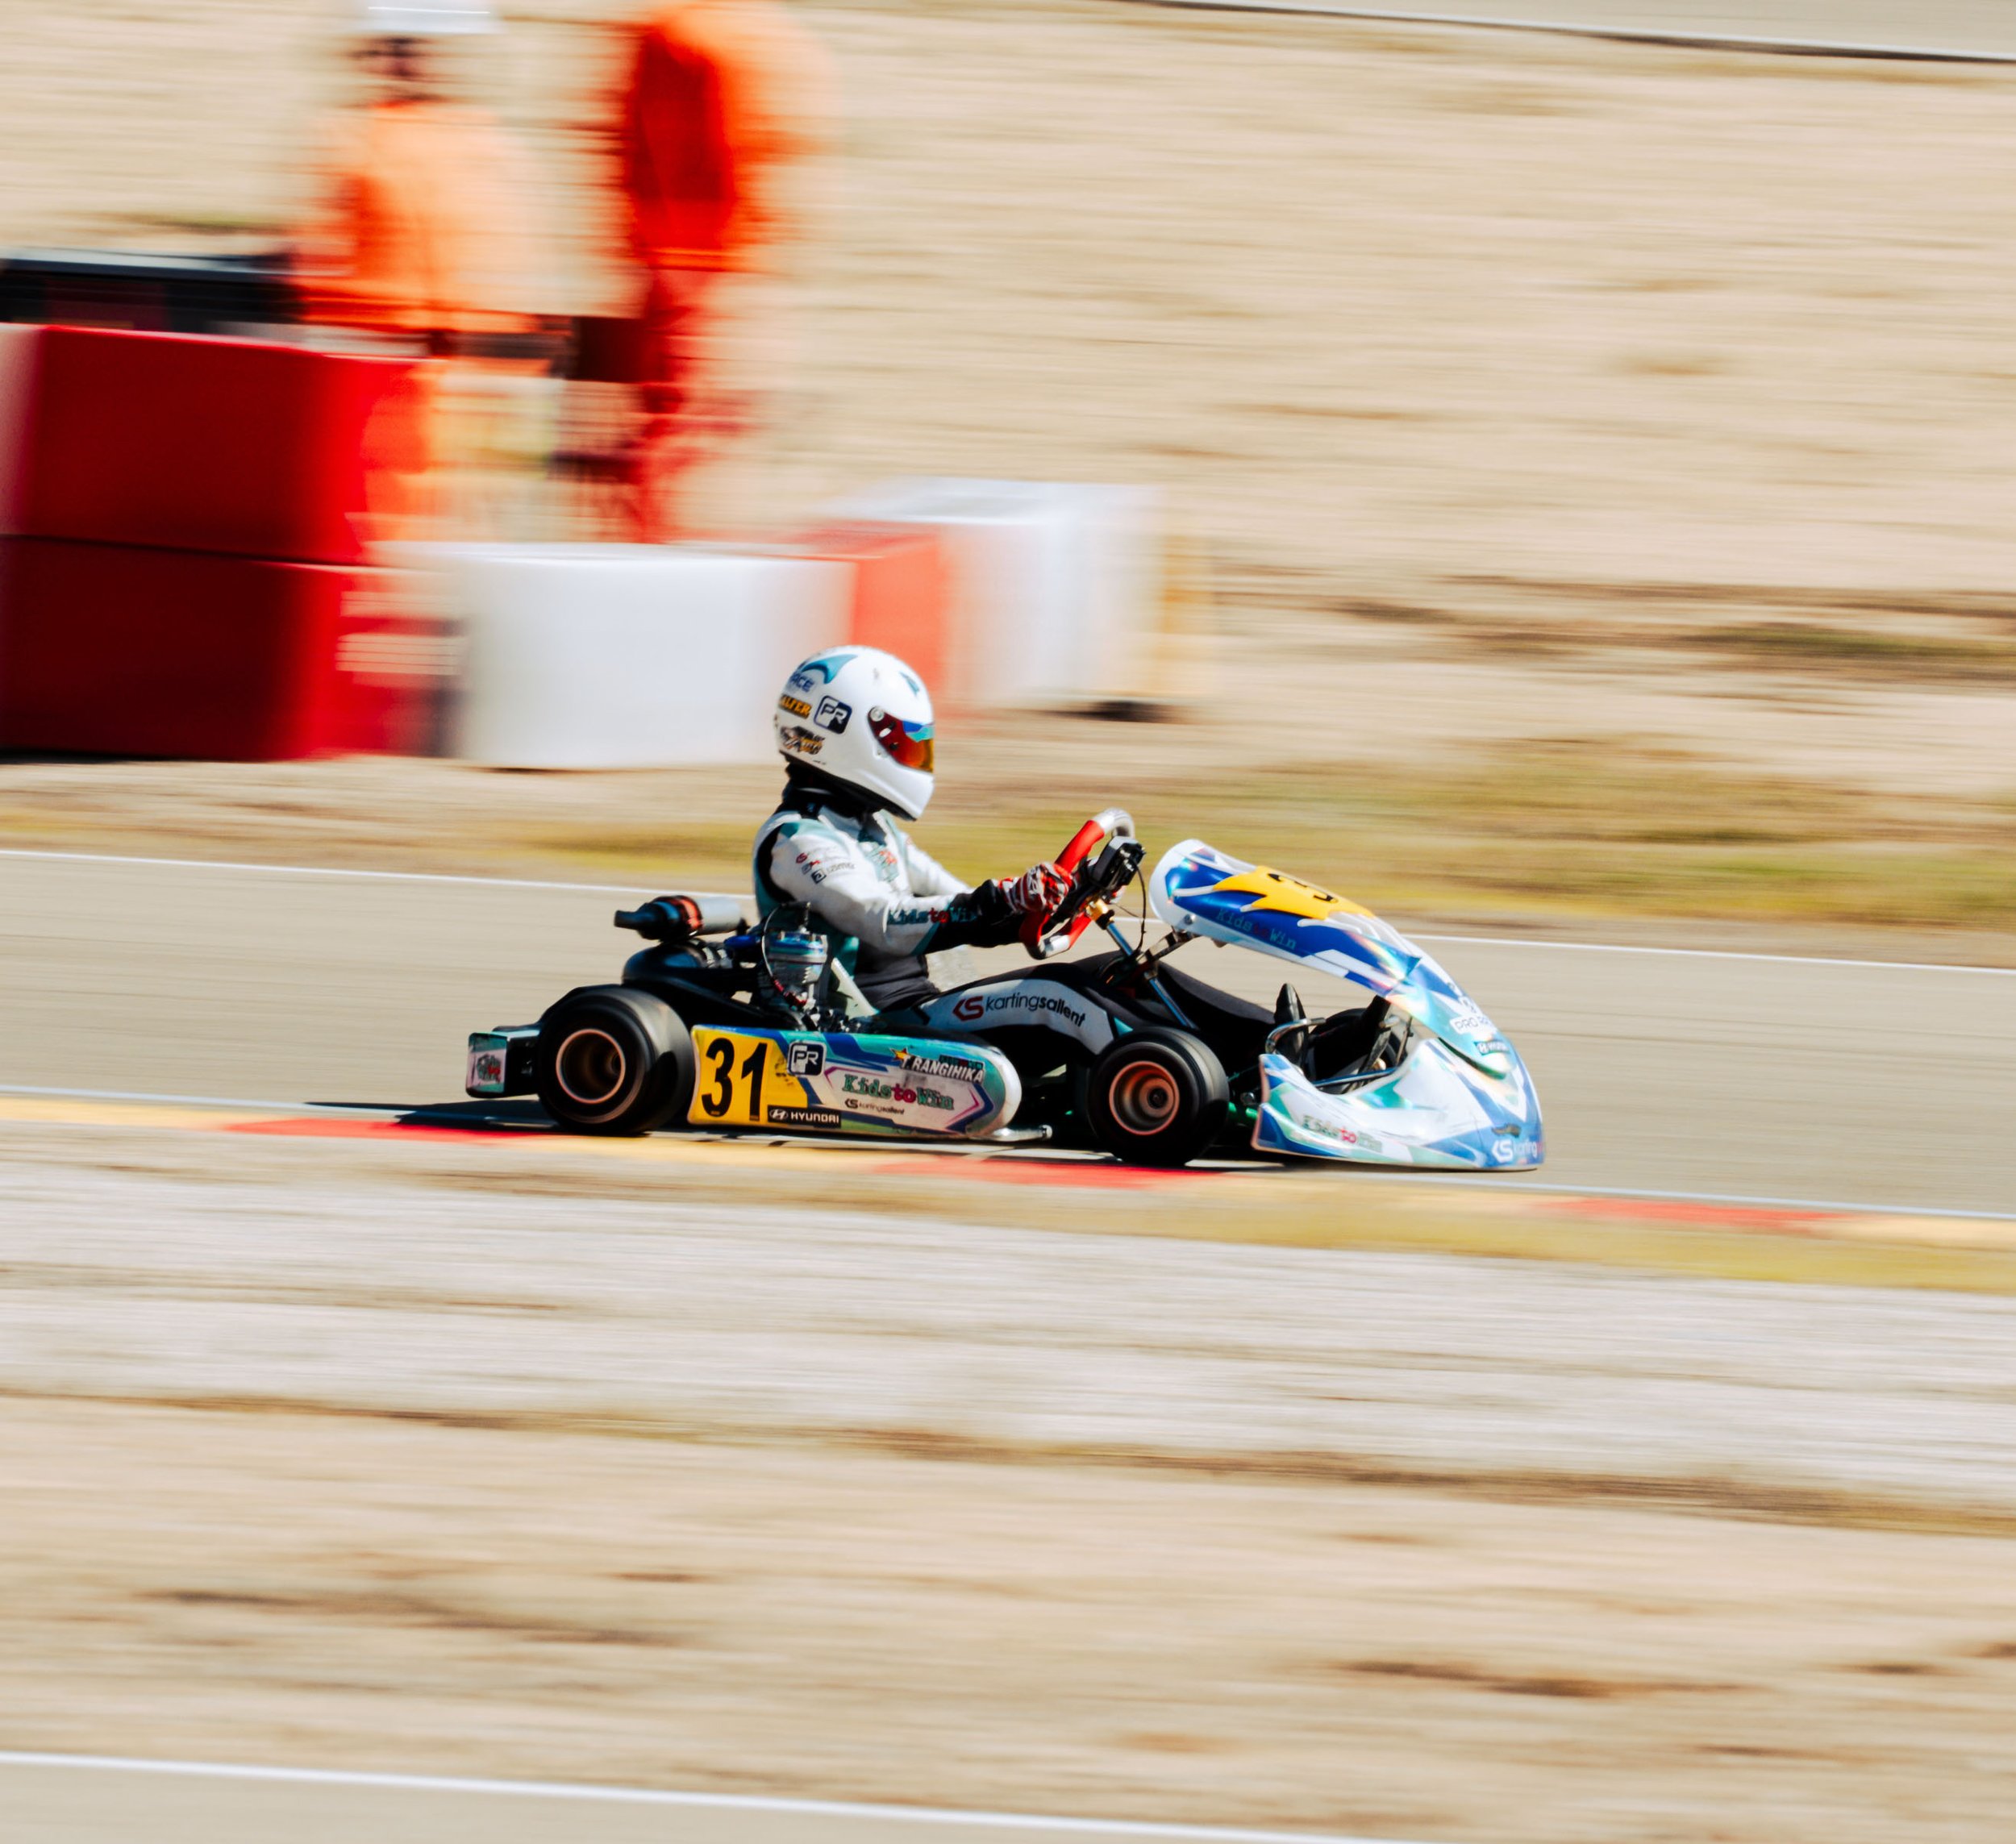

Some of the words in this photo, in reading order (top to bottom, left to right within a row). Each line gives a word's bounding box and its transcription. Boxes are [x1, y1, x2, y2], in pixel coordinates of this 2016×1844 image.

[701, 1037, 768, 1122] 31
[911, 1055, 985, 1083] RANGIHIKA
[790, 1113, 839, 1124] HYUNDAI
